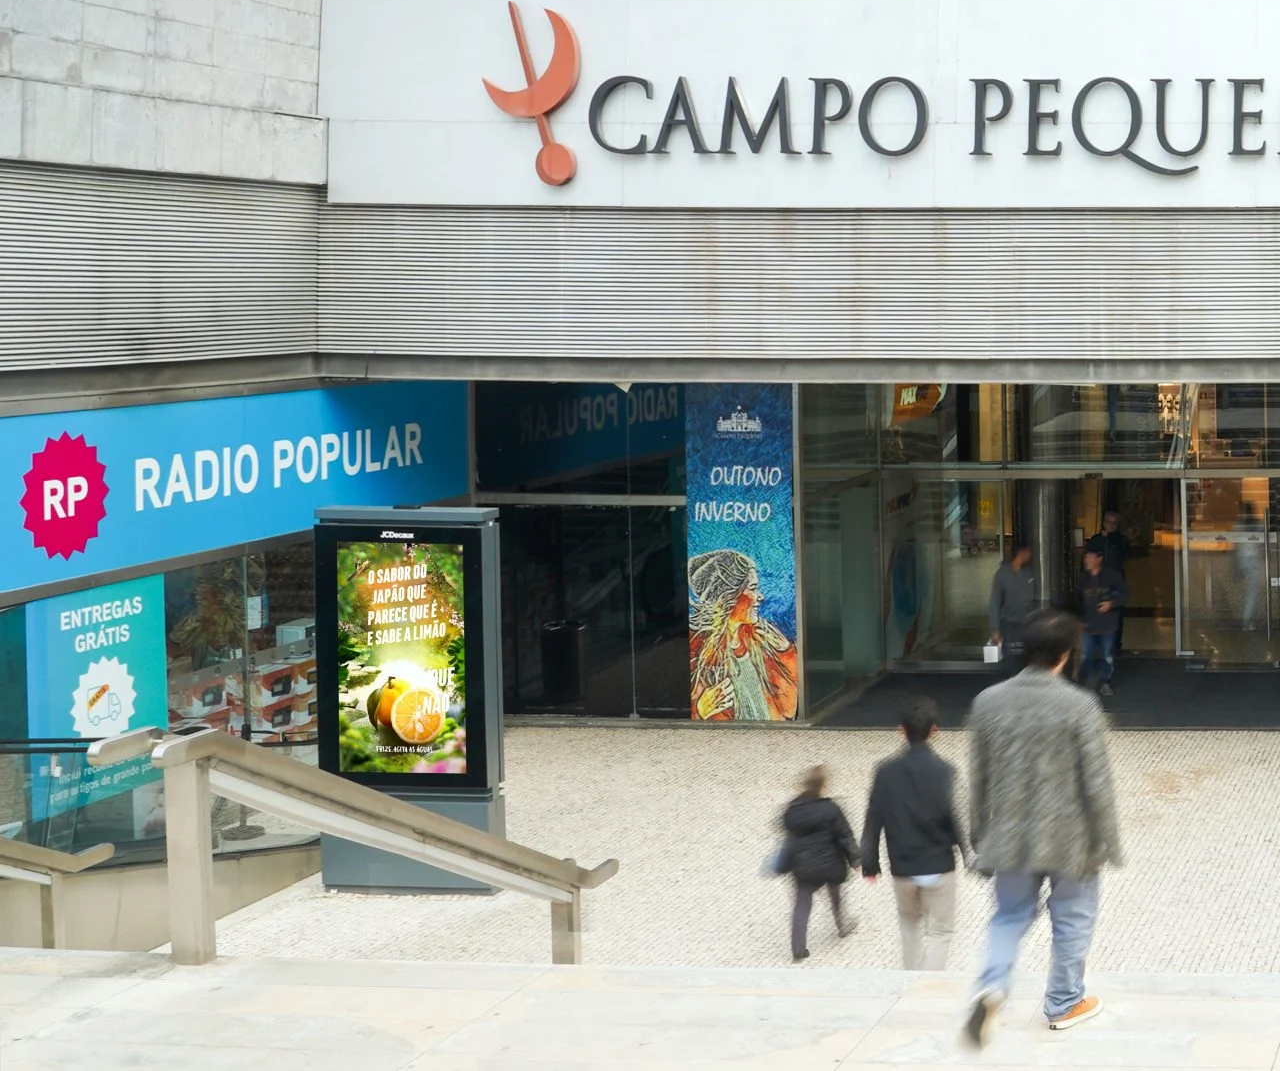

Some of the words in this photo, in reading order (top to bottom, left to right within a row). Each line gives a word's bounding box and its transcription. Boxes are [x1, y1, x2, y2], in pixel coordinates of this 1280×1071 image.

[587, 74, 930, 158] CAMPO
[43, 476, 89, 522] RP
[134, 442, 260, 512] RADIO
[273, 422, 424, 489] POPULAR
[710, 465, 782, 487] OUTONO
[694, 500, 771, 523] INVERNO
[380, 531, 414, 539] JCDecaux
[367, 569, 375, 585] O
[376, 565, 411, 583] SABOR
[413, 563, 427, 579] DO
[371, 584, 405, 605] JAPÃO
[407, 584, 427, 602] QUE
[59, 595, 143, 632] ENTREGAS
[367, 605, 408, 626] PARECE
[409, 604, 429, 621] QUE
[431, 599, 437, 618] É
[74, 618, 130, 654] GRÁTIS
[367, 630, 373, 646] E
[374, 627, 402, 645] SABE
[403, 626, 411, 642] A
[413, 620, 446, 641] LIMÃO
[409, 745, 416, 753] AS
[101, 774, 111, 785] de
[113, 765, 139, 784] grande
